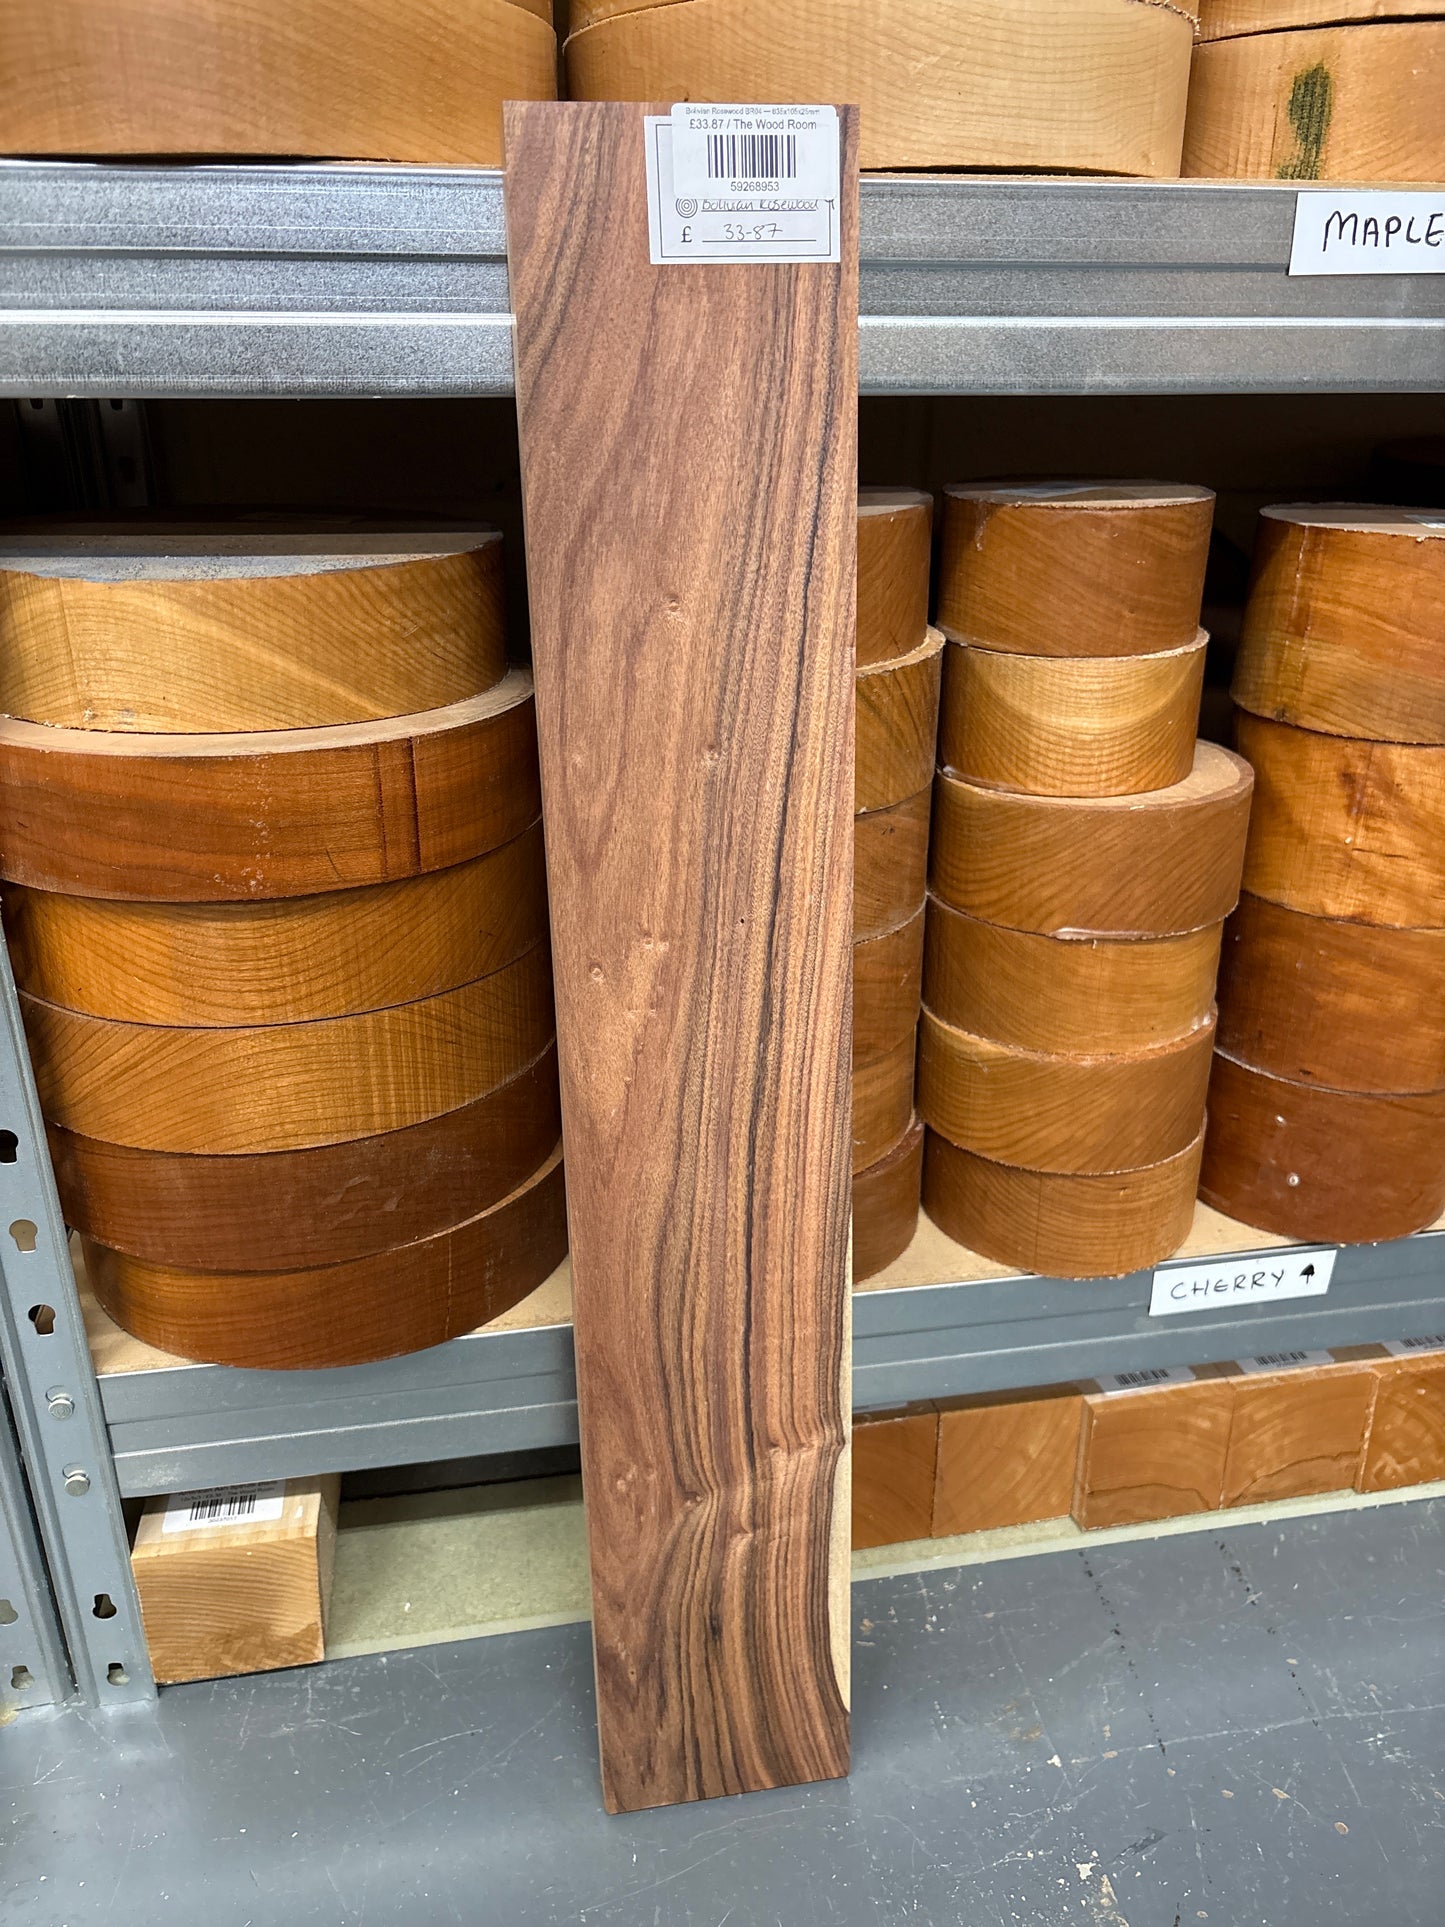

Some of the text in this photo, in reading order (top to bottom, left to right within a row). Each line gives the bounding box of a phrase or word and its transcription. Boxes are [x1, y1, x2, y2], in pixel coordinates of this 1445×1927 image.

[712, 107, 744, 115] Rosewood
[689, 118, 817, 130] £33.87 / The Wood Room
[730, 181, 780, 192] 59268953
[680, 225, 693, 243] £
[1322, 210, 1445, 252] MAPLE
[1170, 1269, 1285, 1300] CHERRY
